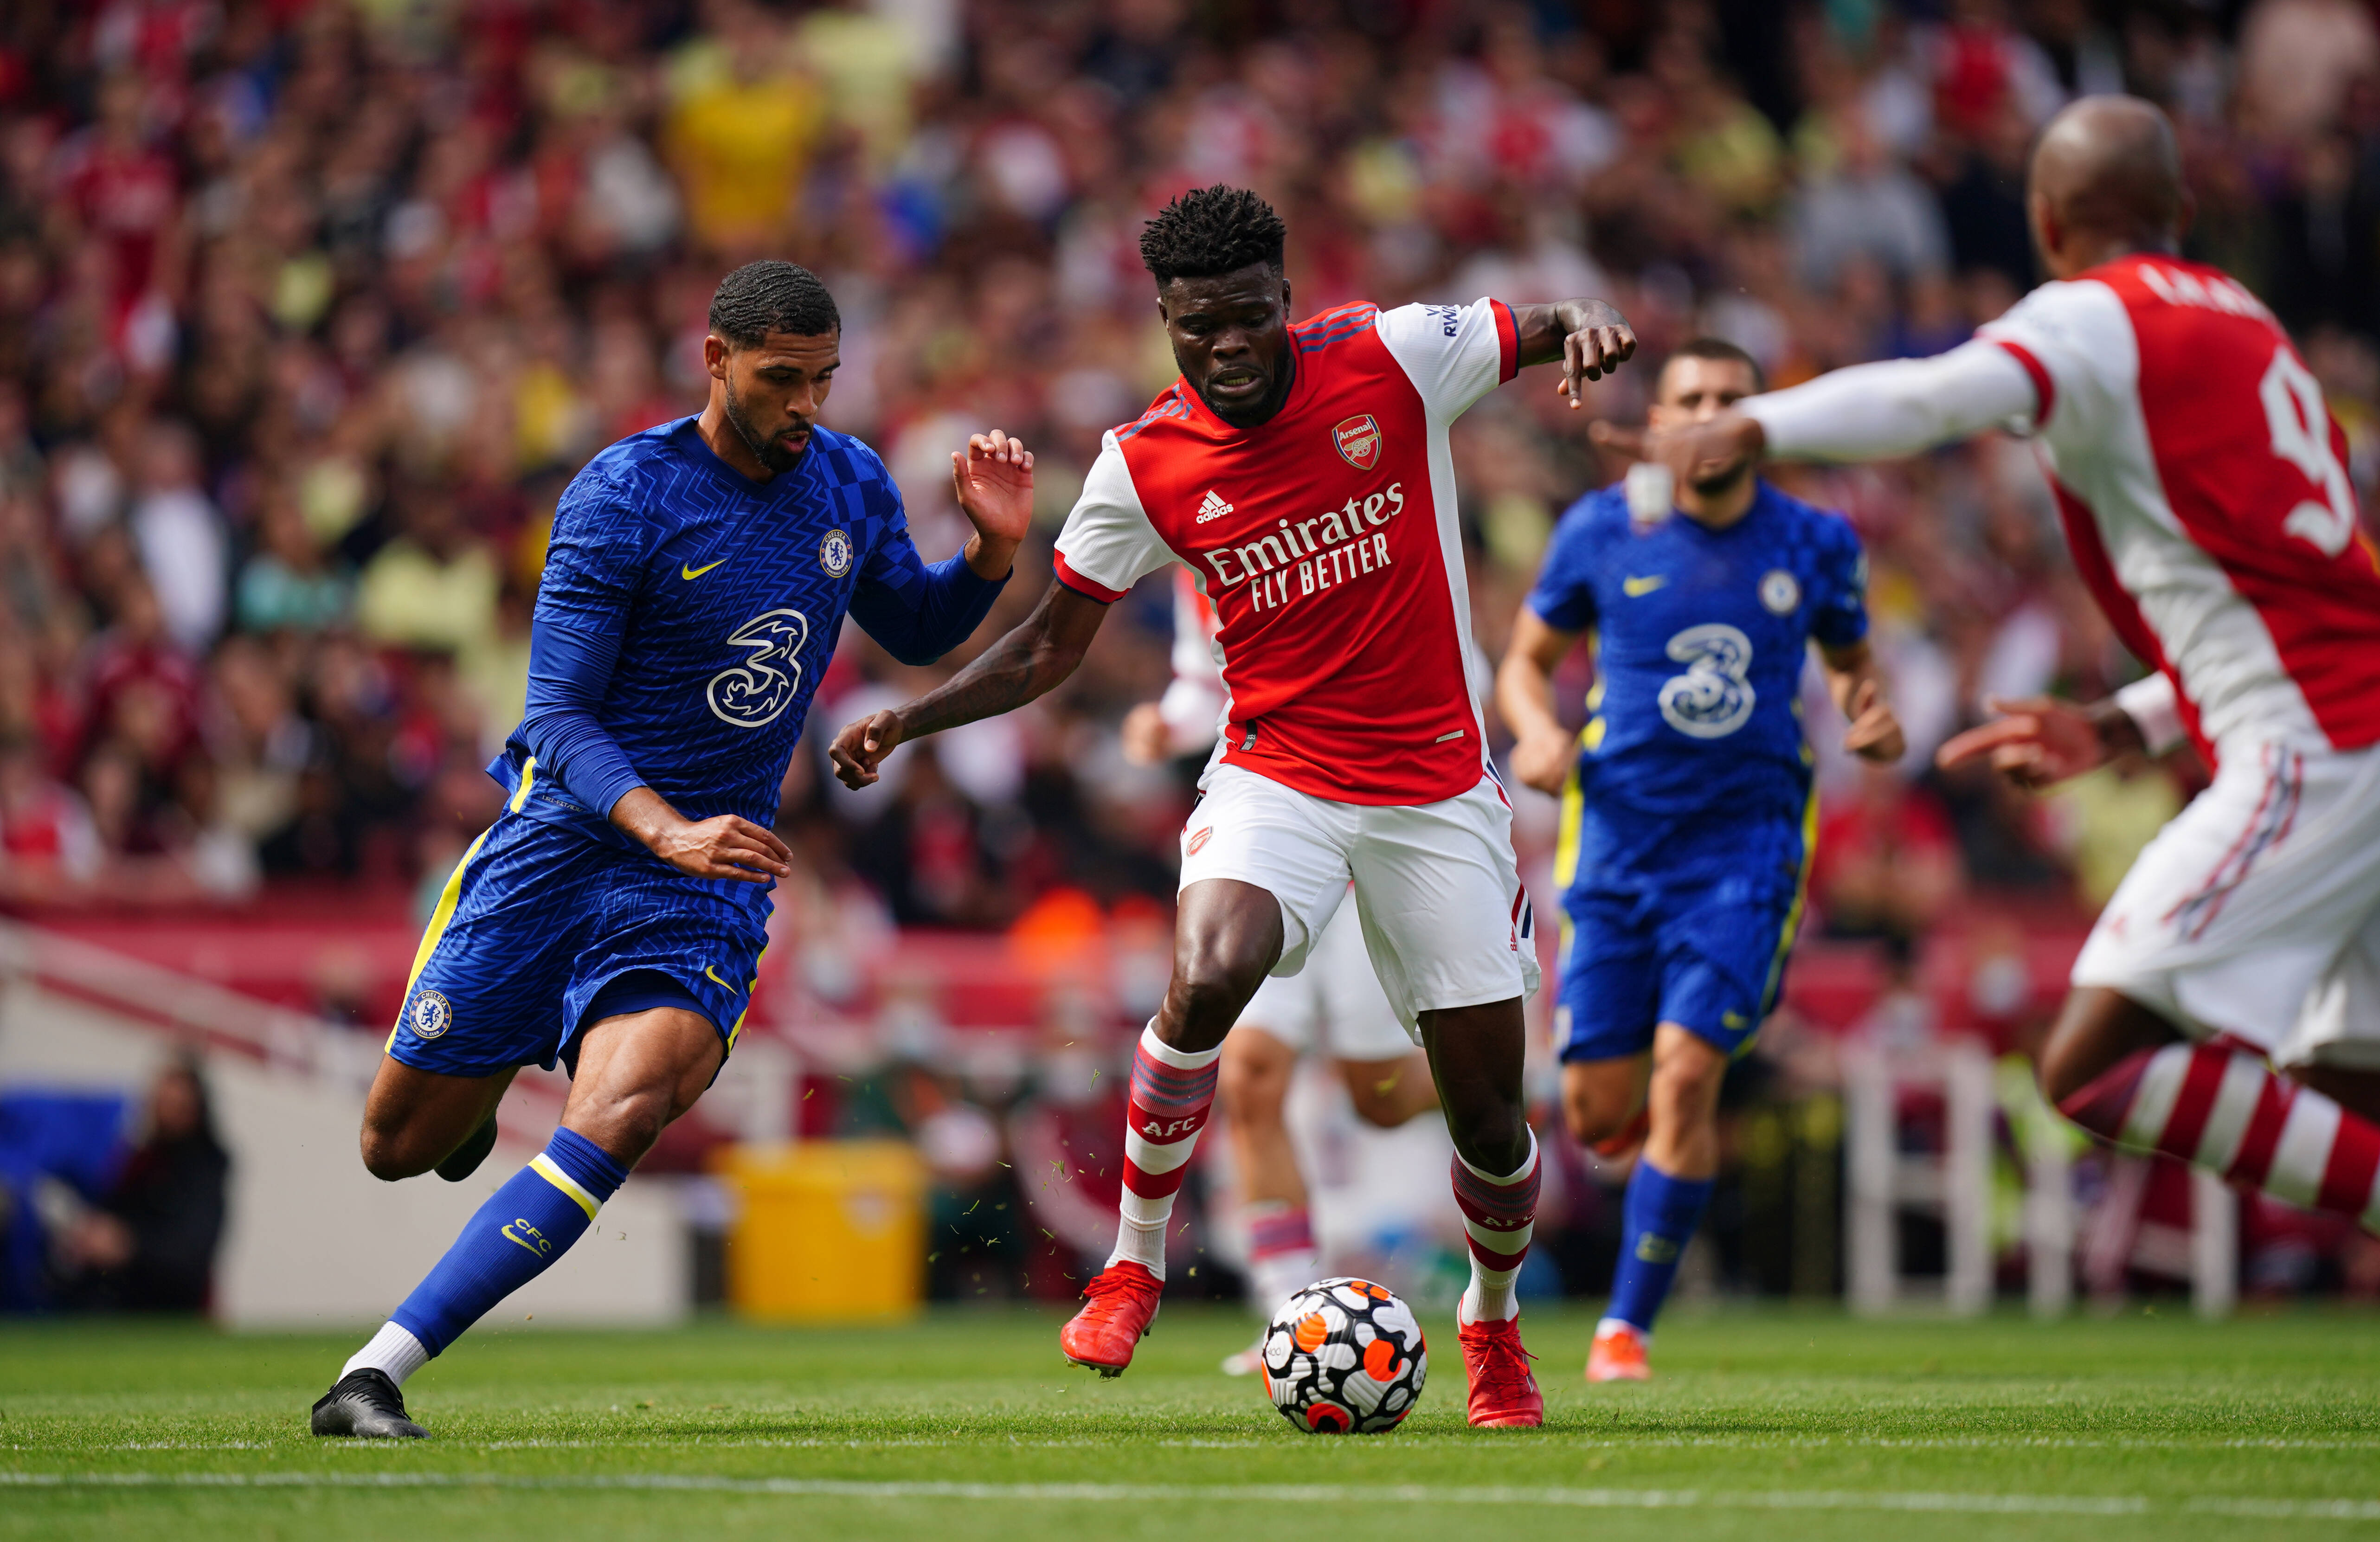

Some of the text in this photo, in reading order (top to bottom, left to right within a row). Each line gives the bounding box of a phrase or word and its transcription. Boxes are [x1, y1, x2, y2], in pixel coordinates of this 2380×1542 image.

[1339, 421, 1371, 441] Arsenal
[2258, 344, 2356, 559] 9
[1196, 503, 1234, 524] adidas
[825, 531, 846, 543] CHELSEA
[1203, 482, 1404, 586] Emirates
[1251, 532, 1392, 612] FLY BETTER
[707, 608, 808, 728] 3
[1657, 623, 1756, 739] 3
[421, 992, 447, 1009] CHELSEA
[412, 1022, 428, 1036] FOOTBALL
[1142, 1117, 1196, 1137] AFC
[515, 1218, 552, 1252] CFC
